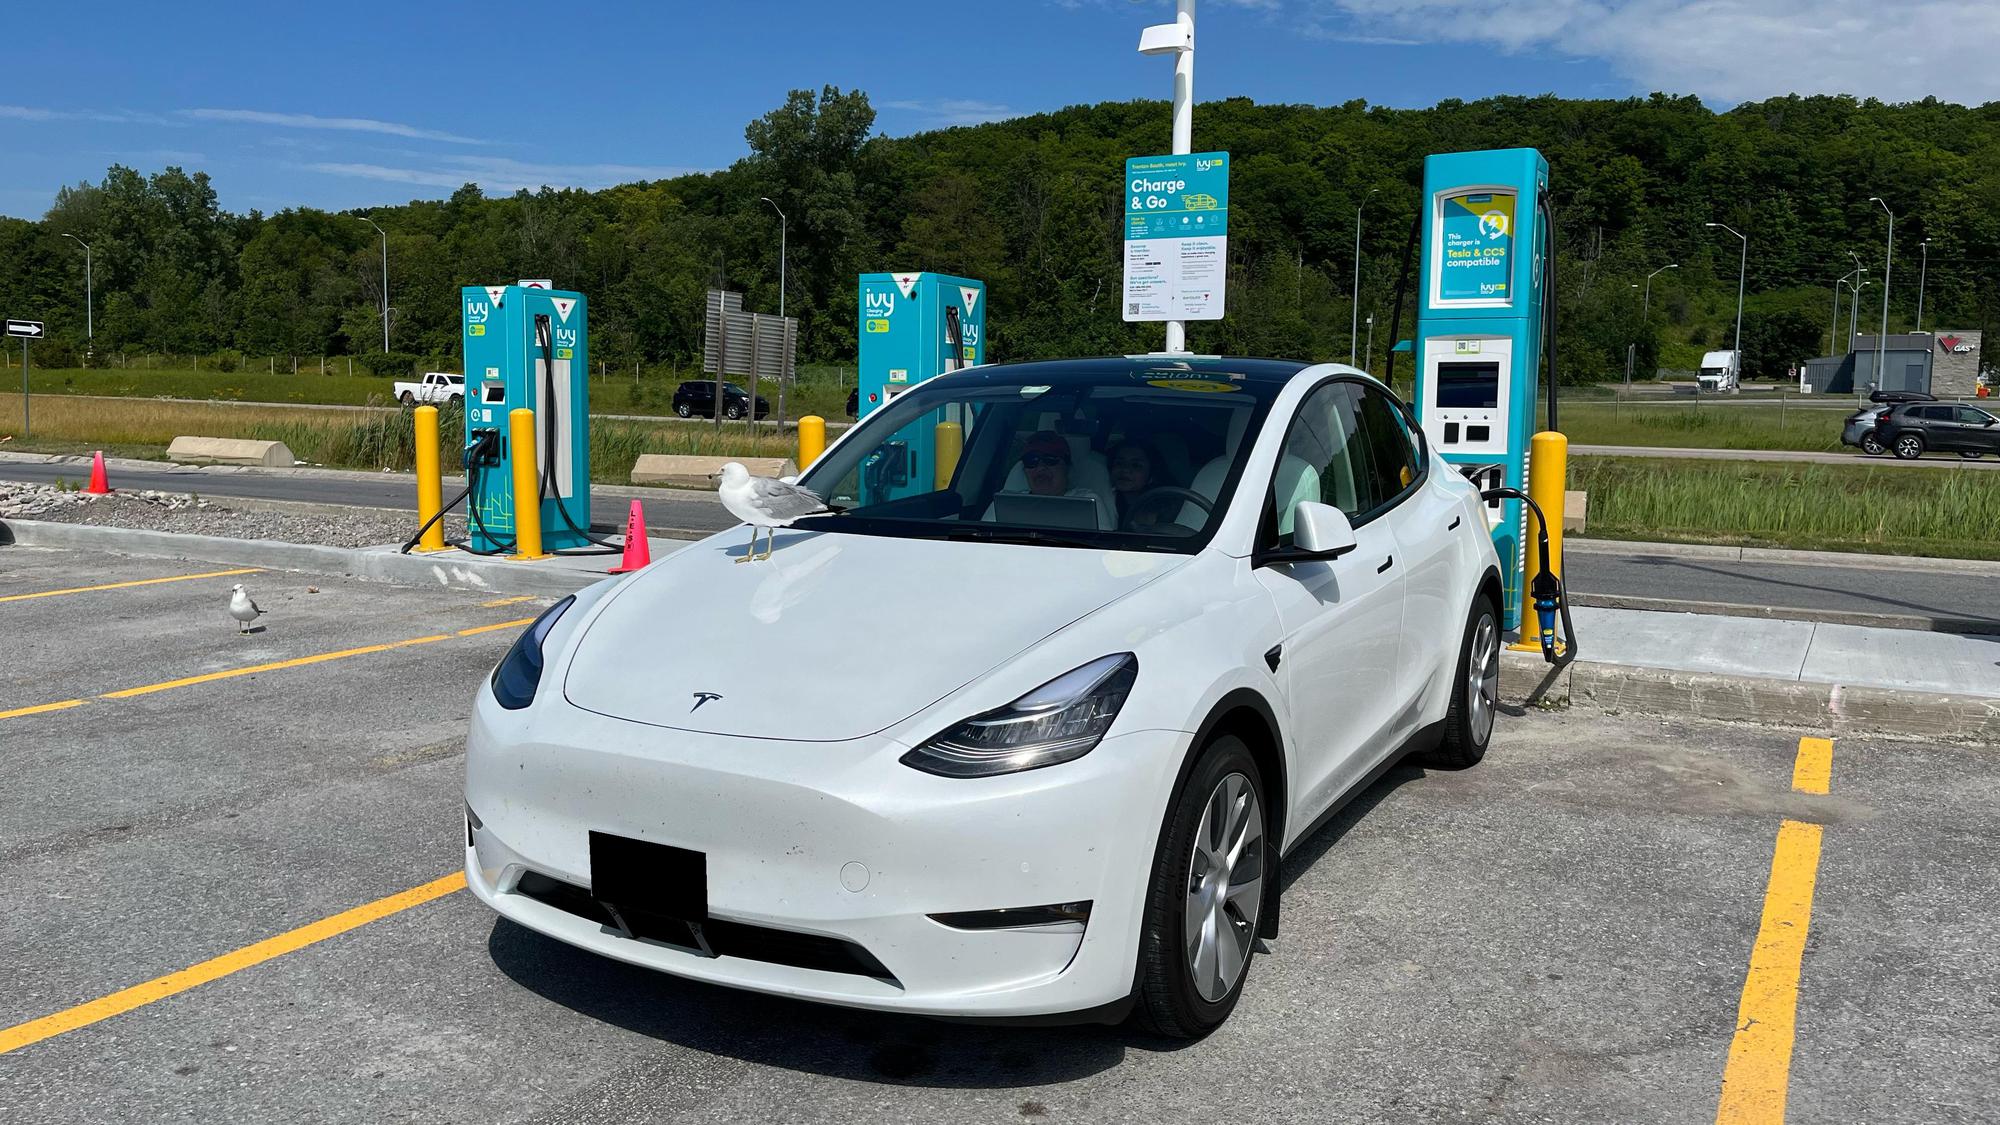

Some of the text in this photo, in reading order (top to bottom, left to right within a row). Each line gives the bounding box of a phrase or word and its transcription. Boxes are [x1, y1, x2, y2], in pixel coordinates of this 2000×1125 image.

[1196, 158, 1210, 171] ivy
[1131, 178, 1186, 194] Charge
[1131, 195, 1167, 210] & Go
[1447, 239, 1474, 247] charger
[1448, 233, 1462, 241] This
[1447, 247, 1505, 258] Tesla & CCS
[1446, 257, 1500, 268] compatible
[1480, 282, 1495, 294] ivy
[866, 288, 895, 317] ivy
[467, 298, 489, 323] ivy
[556, 326, 576, 348] ivy
[963, 319, 979, 346] ivy
